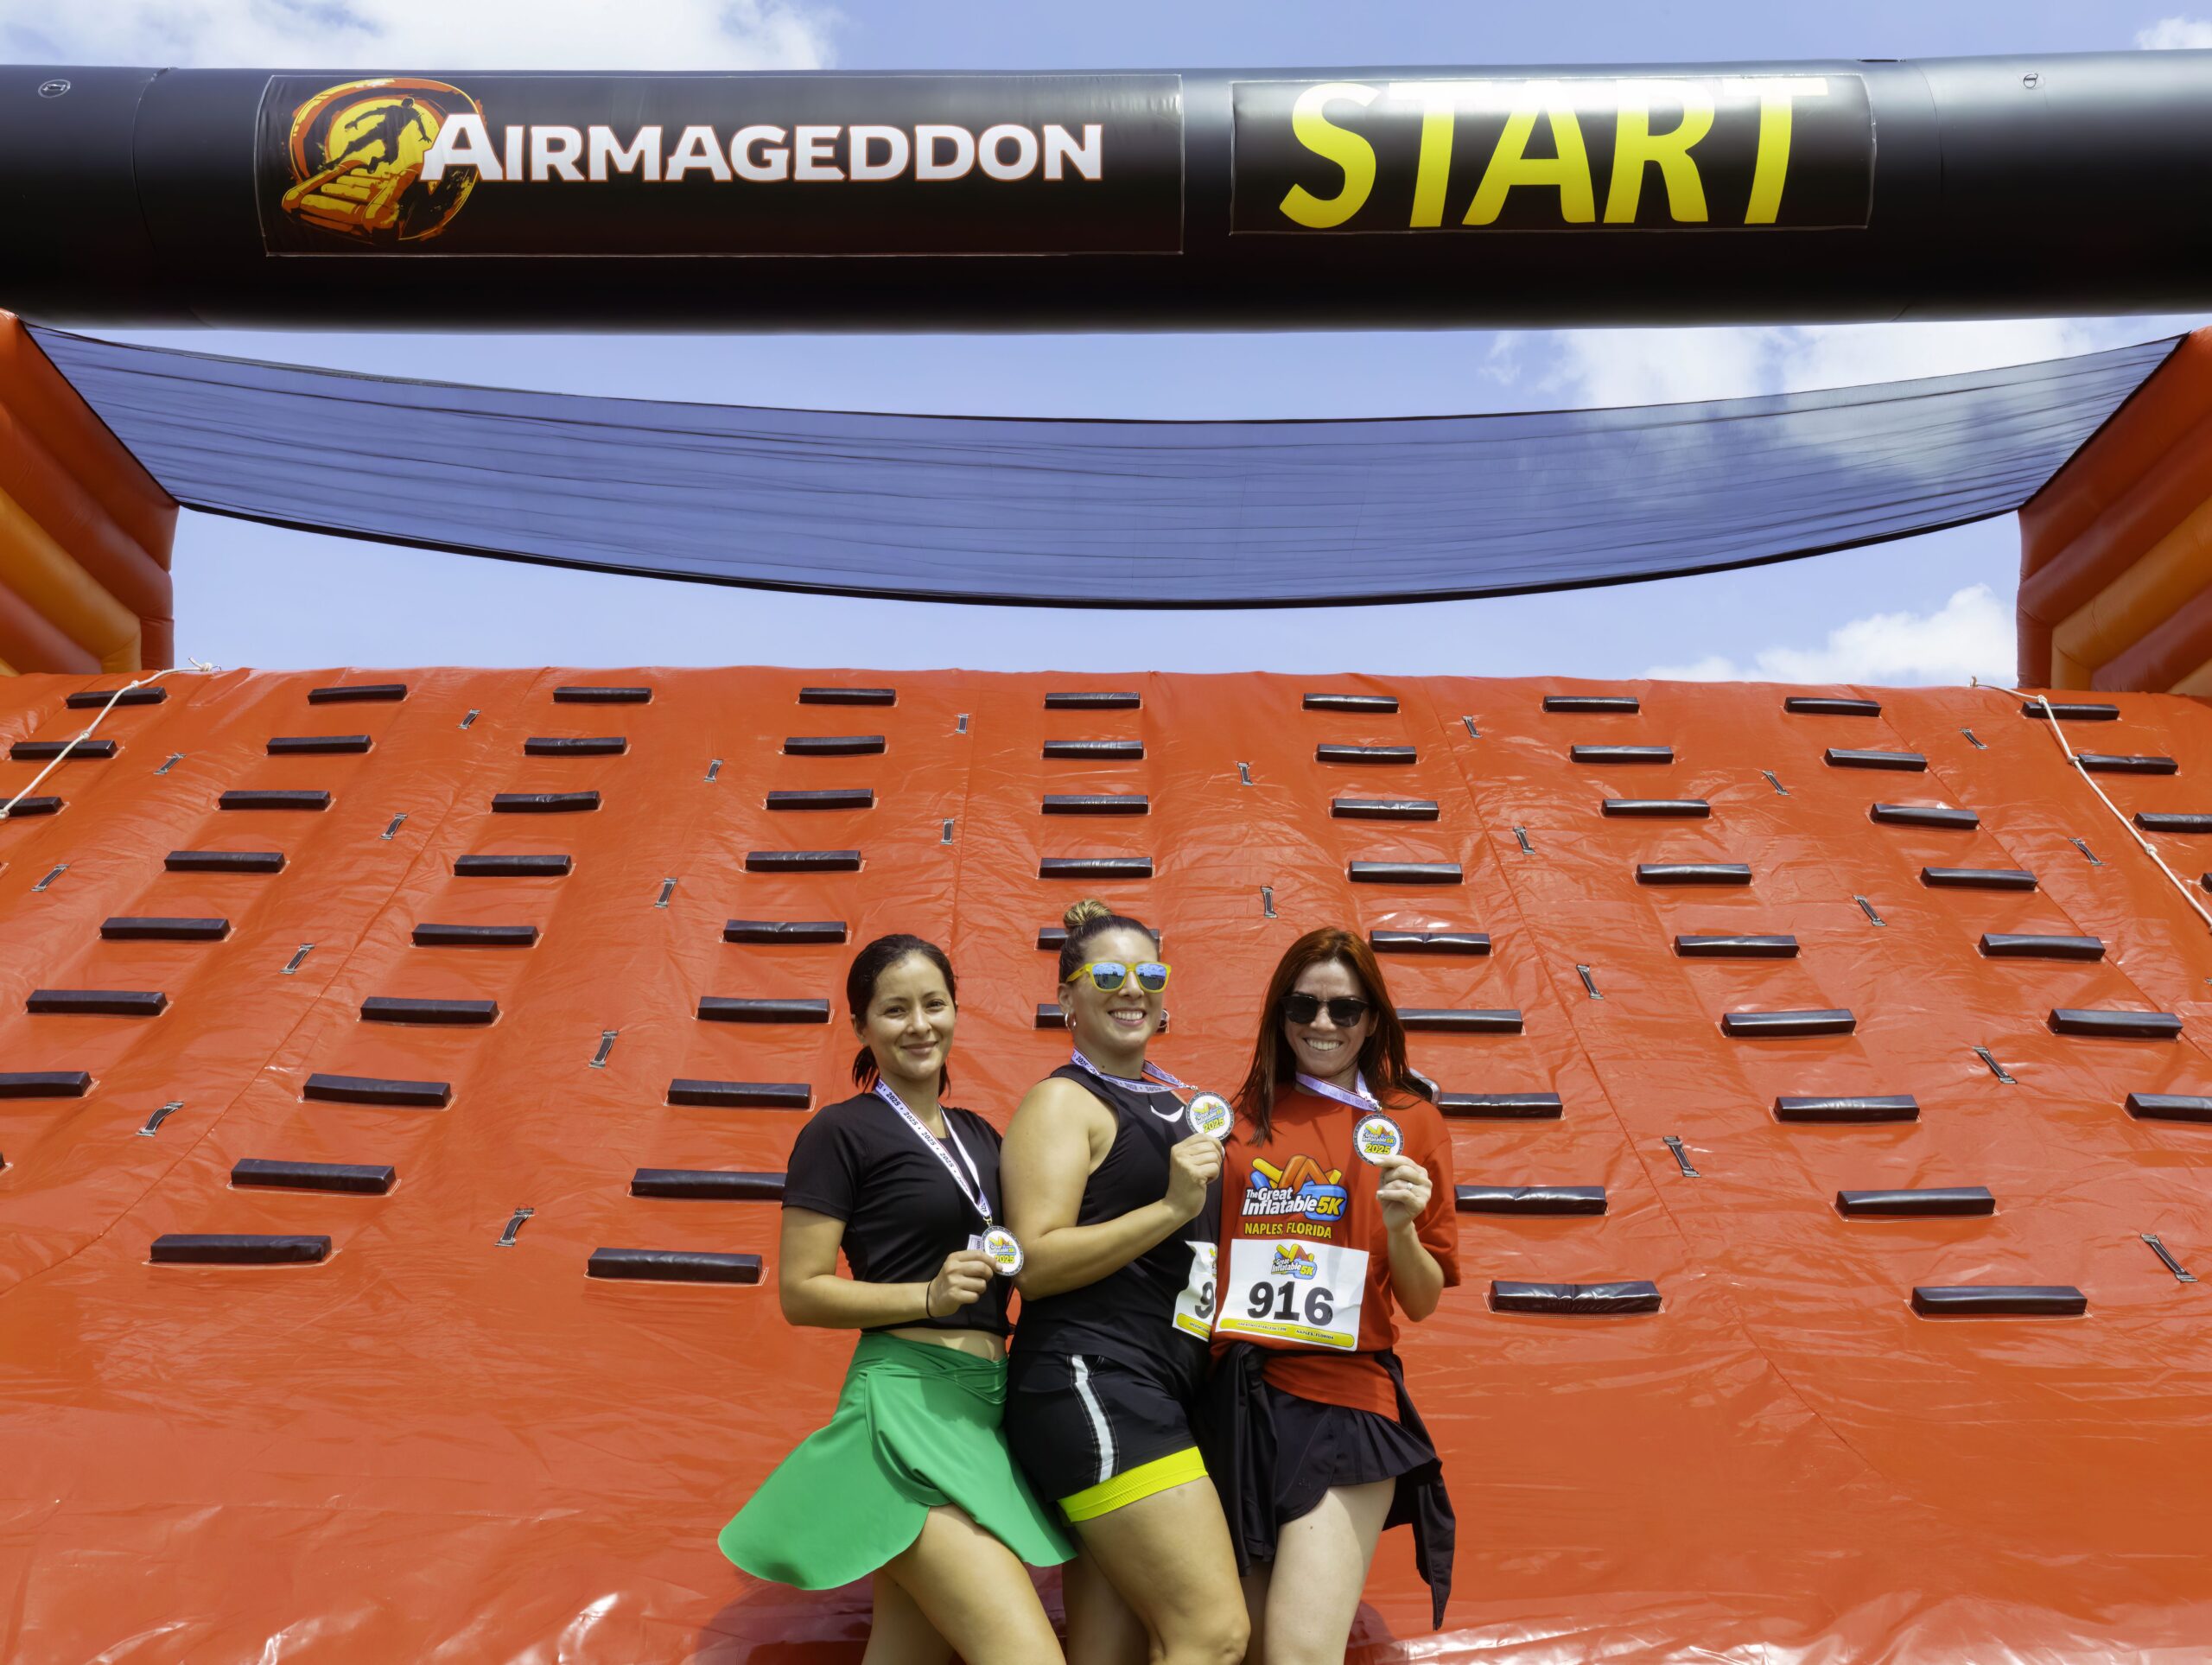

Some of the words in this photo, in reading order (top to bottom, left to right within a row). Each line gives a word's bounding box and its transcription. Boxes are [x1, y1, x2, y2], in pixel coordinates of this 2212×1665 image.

[421, 113, 1103, 182] AIRMAGEDDON
[1279, 78, 1828, 228] START
[886, 1091, 901, 1107] 2025
[904, 1111, 918, 1126] 2025
[921, 1131, 937, 1146] 2025
[939, 1152, 954, 1167] 2025
[1203, 1117, 1224, 1133] 2025
[1364, 1143, 1391, 1154] 2025
[1246, 1189, 1258, 1198] The
[1257, 1187, 1294, 1201] Great
[1242, 1195, 1318, 1216] Inflatable
[1316, 1196, 1344, 1216] 5K
[1286, 1222, 1332, 1239] FLORIDA
[1300, 1265, 1314, 1275] 5K
[1195, 1281, 1215, 1319] 9
[1248, 1281, 1334, 1326] 916
